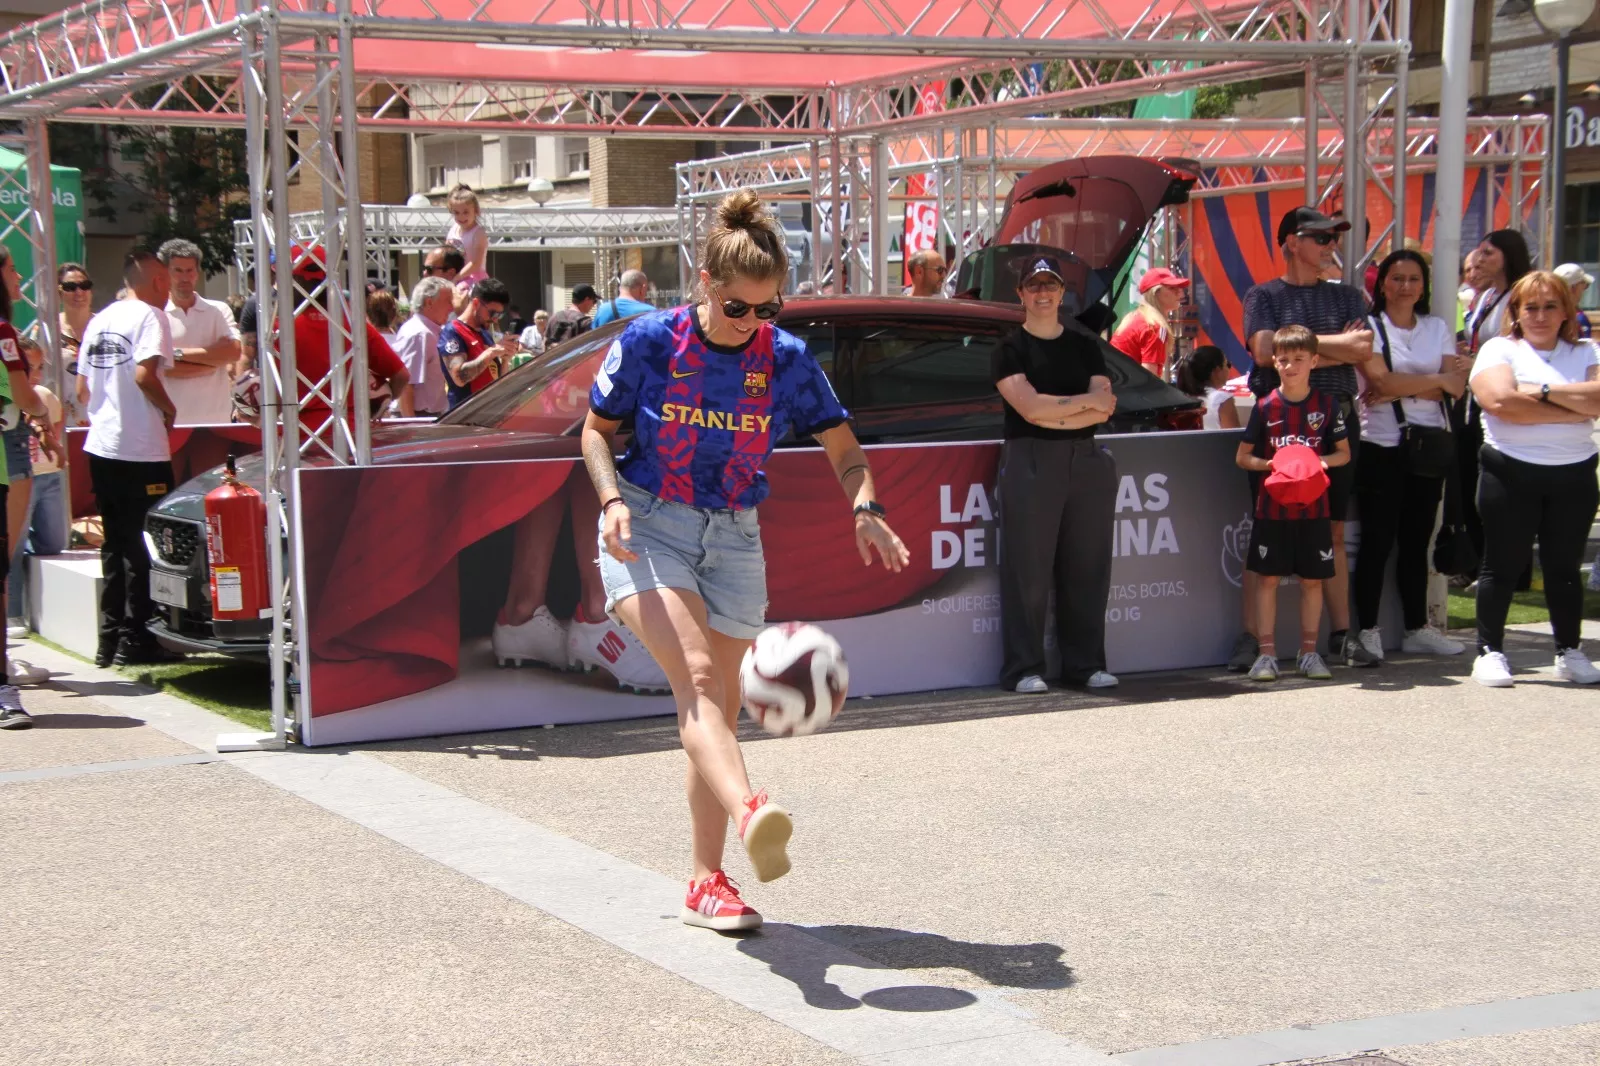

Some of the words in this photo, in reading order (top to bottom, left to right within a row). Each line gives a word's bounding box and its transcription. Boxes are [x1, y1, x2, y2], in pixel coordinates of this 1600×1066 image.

[661, 403, 773, 433] STANLEY
[931, 528, 986, 569] DE
[921, 598, 935, 615] SI
[938, 594, 1001, 614] QUIERES
[1140, 581, 1189, 599] BOTAS,
[1125, 605, 1141, 621] IG
